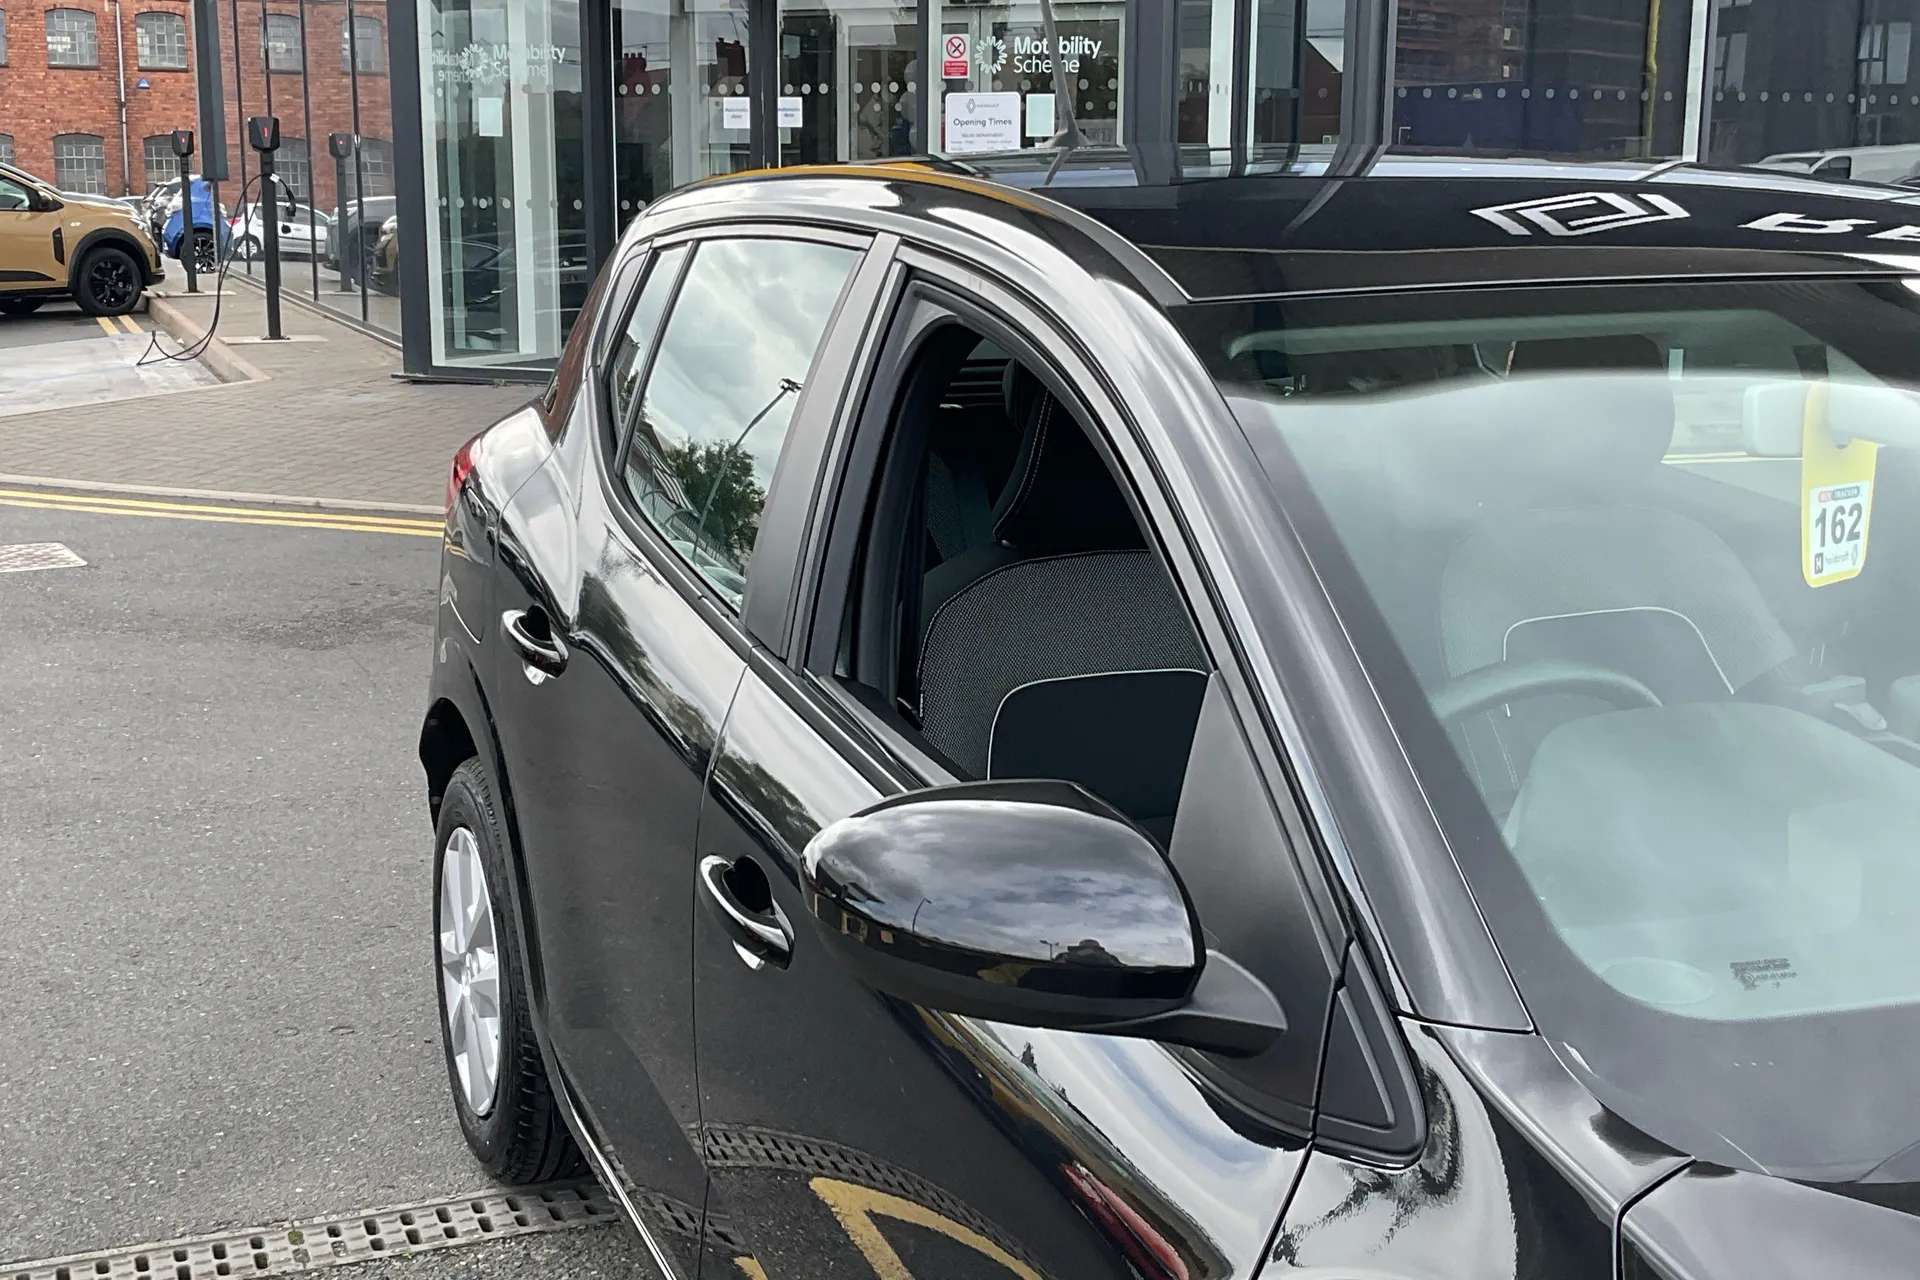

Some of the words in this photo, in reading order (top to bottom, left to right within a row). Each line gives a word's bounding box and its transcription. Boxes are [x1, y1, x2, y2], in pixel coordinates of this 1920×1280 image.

[1014, 36, 1102, 59] Motbility
[494, 61, 548, 78] Scme
[953, 118, 987, 127] Opening
[988, 118, 1012, 126] Times
[1815, 502, 1863, 548] 162
